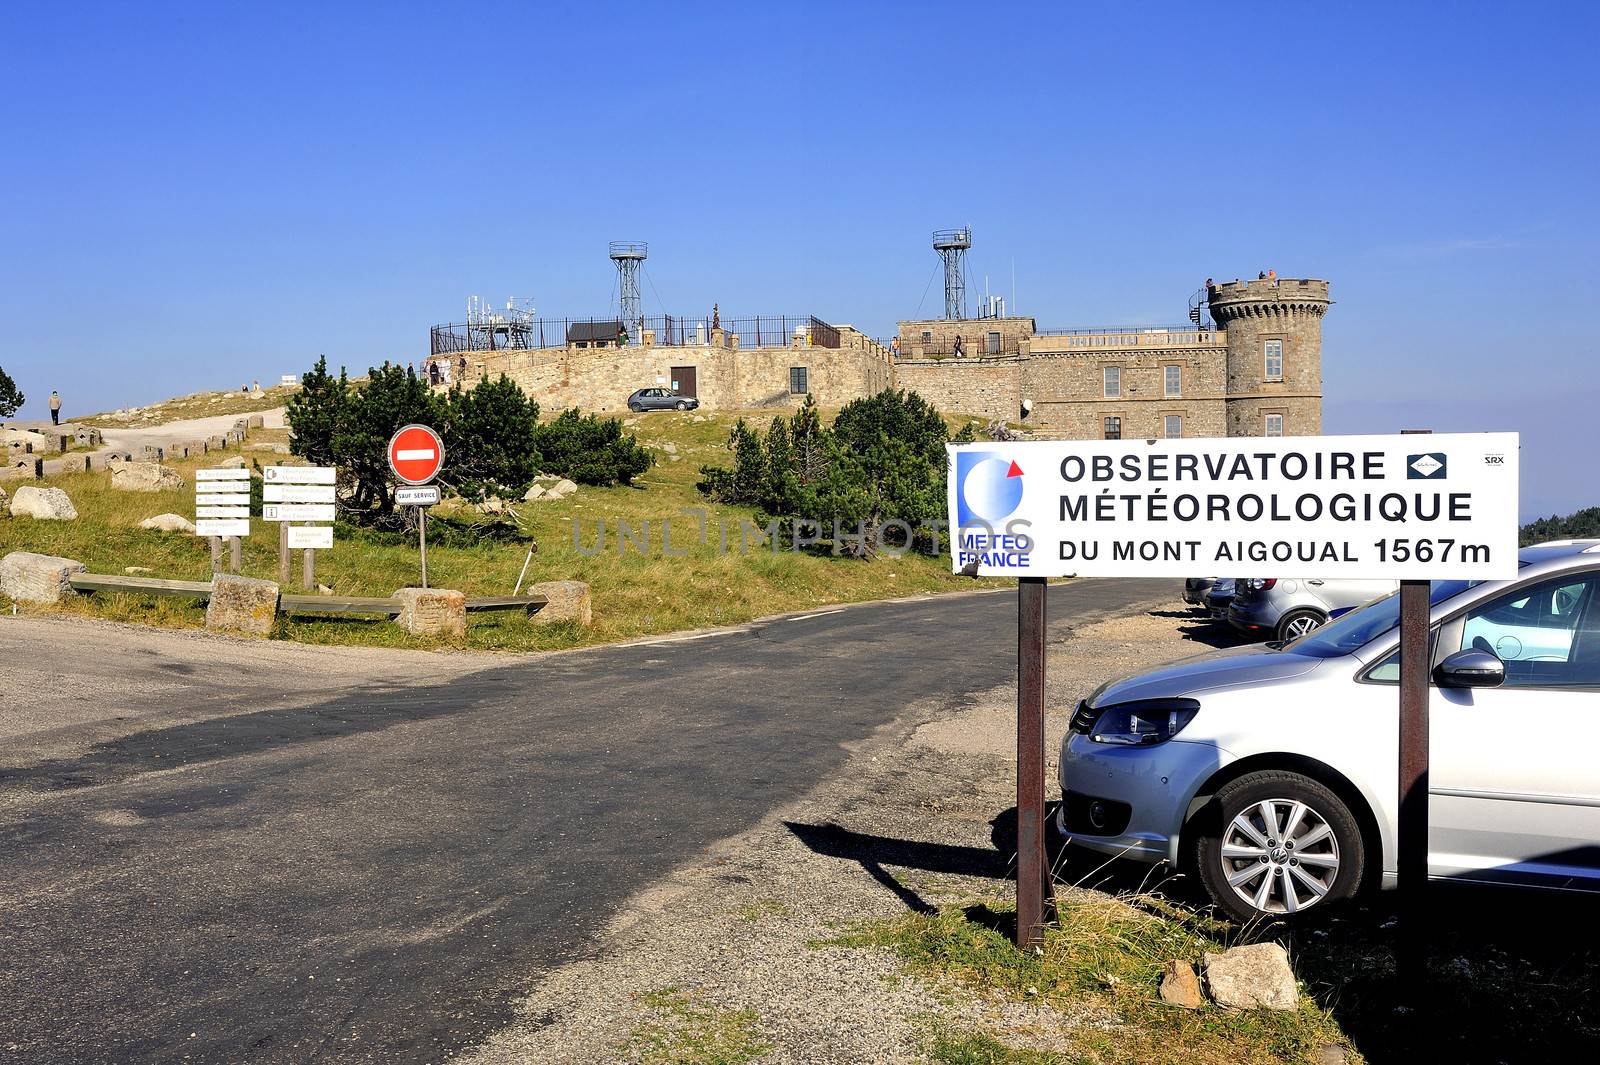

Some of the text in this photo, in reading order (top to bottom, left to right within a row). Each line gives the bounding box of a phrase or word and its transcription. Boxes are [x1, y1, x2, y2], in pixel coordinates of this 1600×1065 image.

[1060, 452, 1385, 483] OBSERVATOIRE
[1059, 488, 1472, 524] MÉTÉOROLOGIQUE
[959, 534, 1029, 549] METEO
[1059, 538, 1490, 563] DU MONT AIGOUAL 1567m
